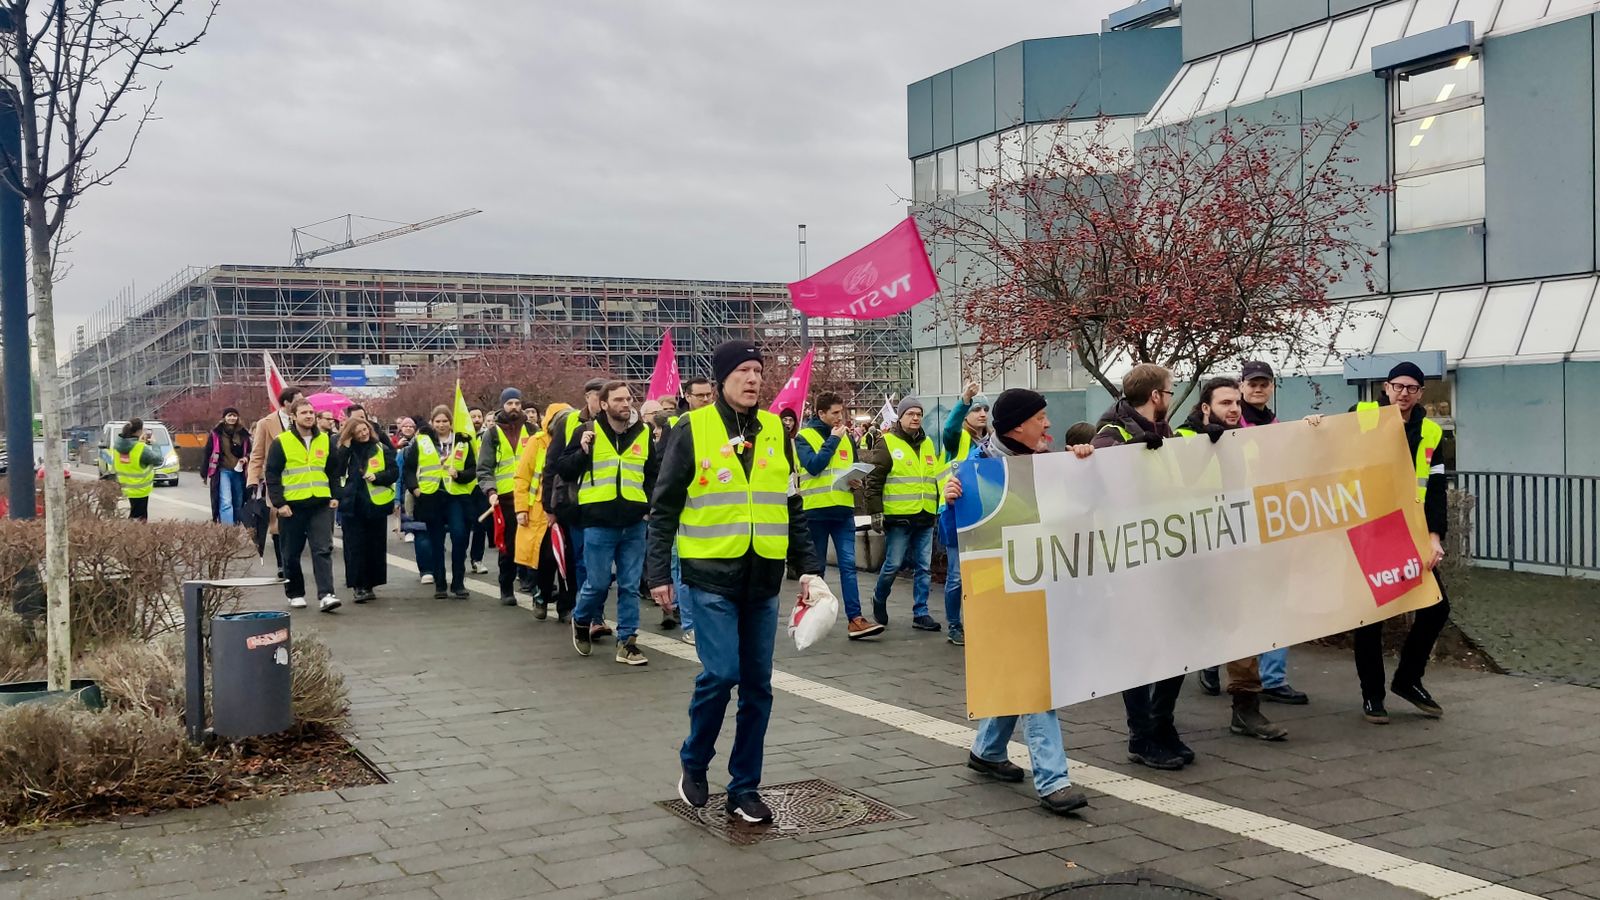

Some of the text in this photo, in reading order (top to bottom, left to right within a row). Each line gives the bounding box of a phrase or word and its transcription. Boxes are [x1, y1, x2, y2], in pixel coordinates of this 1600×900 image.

[1007, 480, 1367, 586] UNIVERSITÄT BONN
[1368, 557, 1421, 589] ver.di
